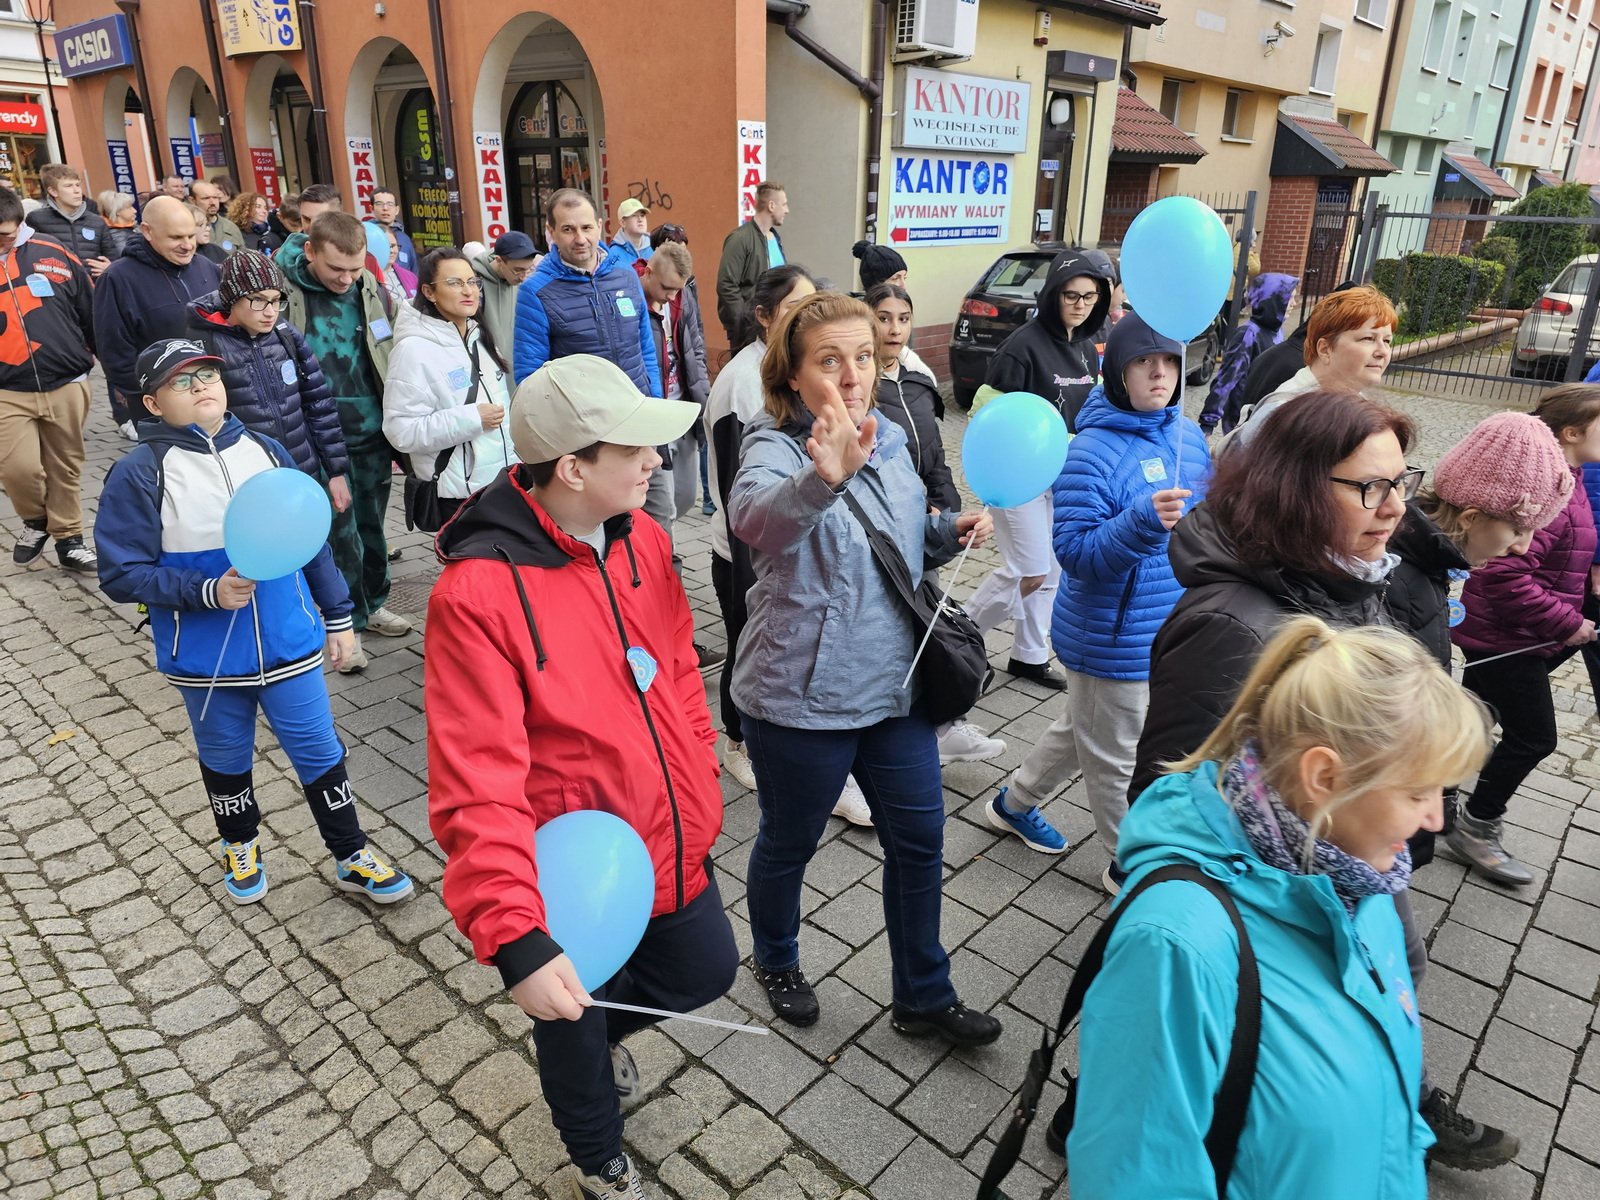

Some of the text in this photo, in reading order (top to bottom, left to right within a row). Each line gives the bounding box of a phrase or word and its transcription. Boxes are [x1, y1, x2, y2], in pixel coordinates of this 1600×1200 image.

[272, 0, 294, 46] GS
[63, 28, 111, 68] CASIO
[913, 78, 1020, 120] KANTOR
[740, 127, 764, 138] Cent
[913, 118, 1020, 136] WECHSELSTUBE
[349, 140, 371, 149] Cent
[476, 136, 500, 145] Cent
[935, 135, 998, 148] EXCHANGE
[353, 152, 376, 222] KANT
[743, 144, 762, 221] KAN
[895, 157, 1008, 195] KANTOR
[418, 188, 447, 202] TELEFO
[480, 150, 505, 249] KANTO
[412, 203, 449, 218] KOMÓRK
[894, 205, 1006, 219] WYMIANY WALUT
[211, 790, 253, 816] BRK
